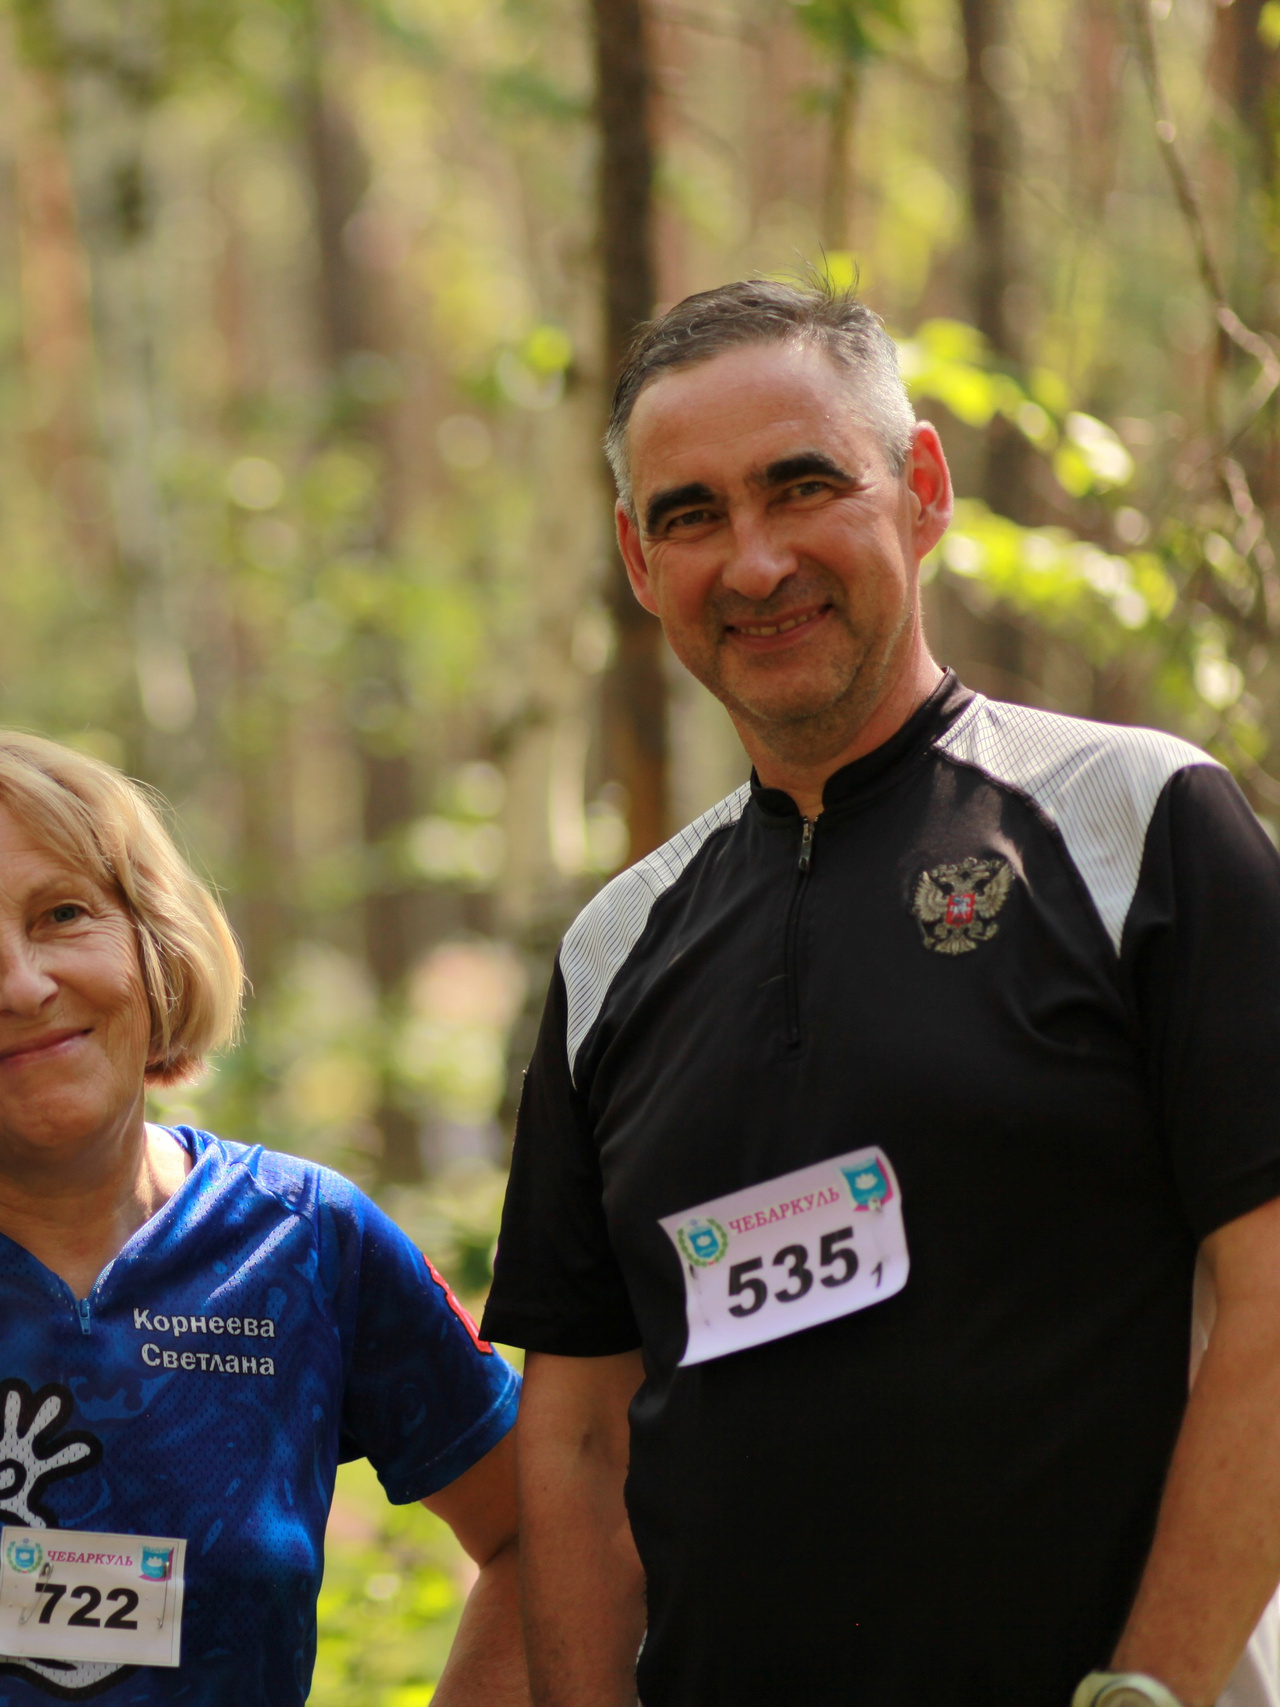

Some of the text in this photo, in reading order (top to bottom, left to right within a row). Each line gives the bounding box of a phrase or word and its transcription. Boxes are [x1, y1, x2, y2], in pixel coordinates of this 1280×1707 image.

[728, 1187, 840, 1234] ЧЕБАРКУЛЬ
[728, 1226, 884, 1318] 535 1
[133, 1307, 276, 1338] Корнеева
[141, 1343, 276, 1376] Светлана
[46, 1549, 134, 1567] ЧЕБАРКУЛЬ
[34, 1582, 140, 1631] 722
